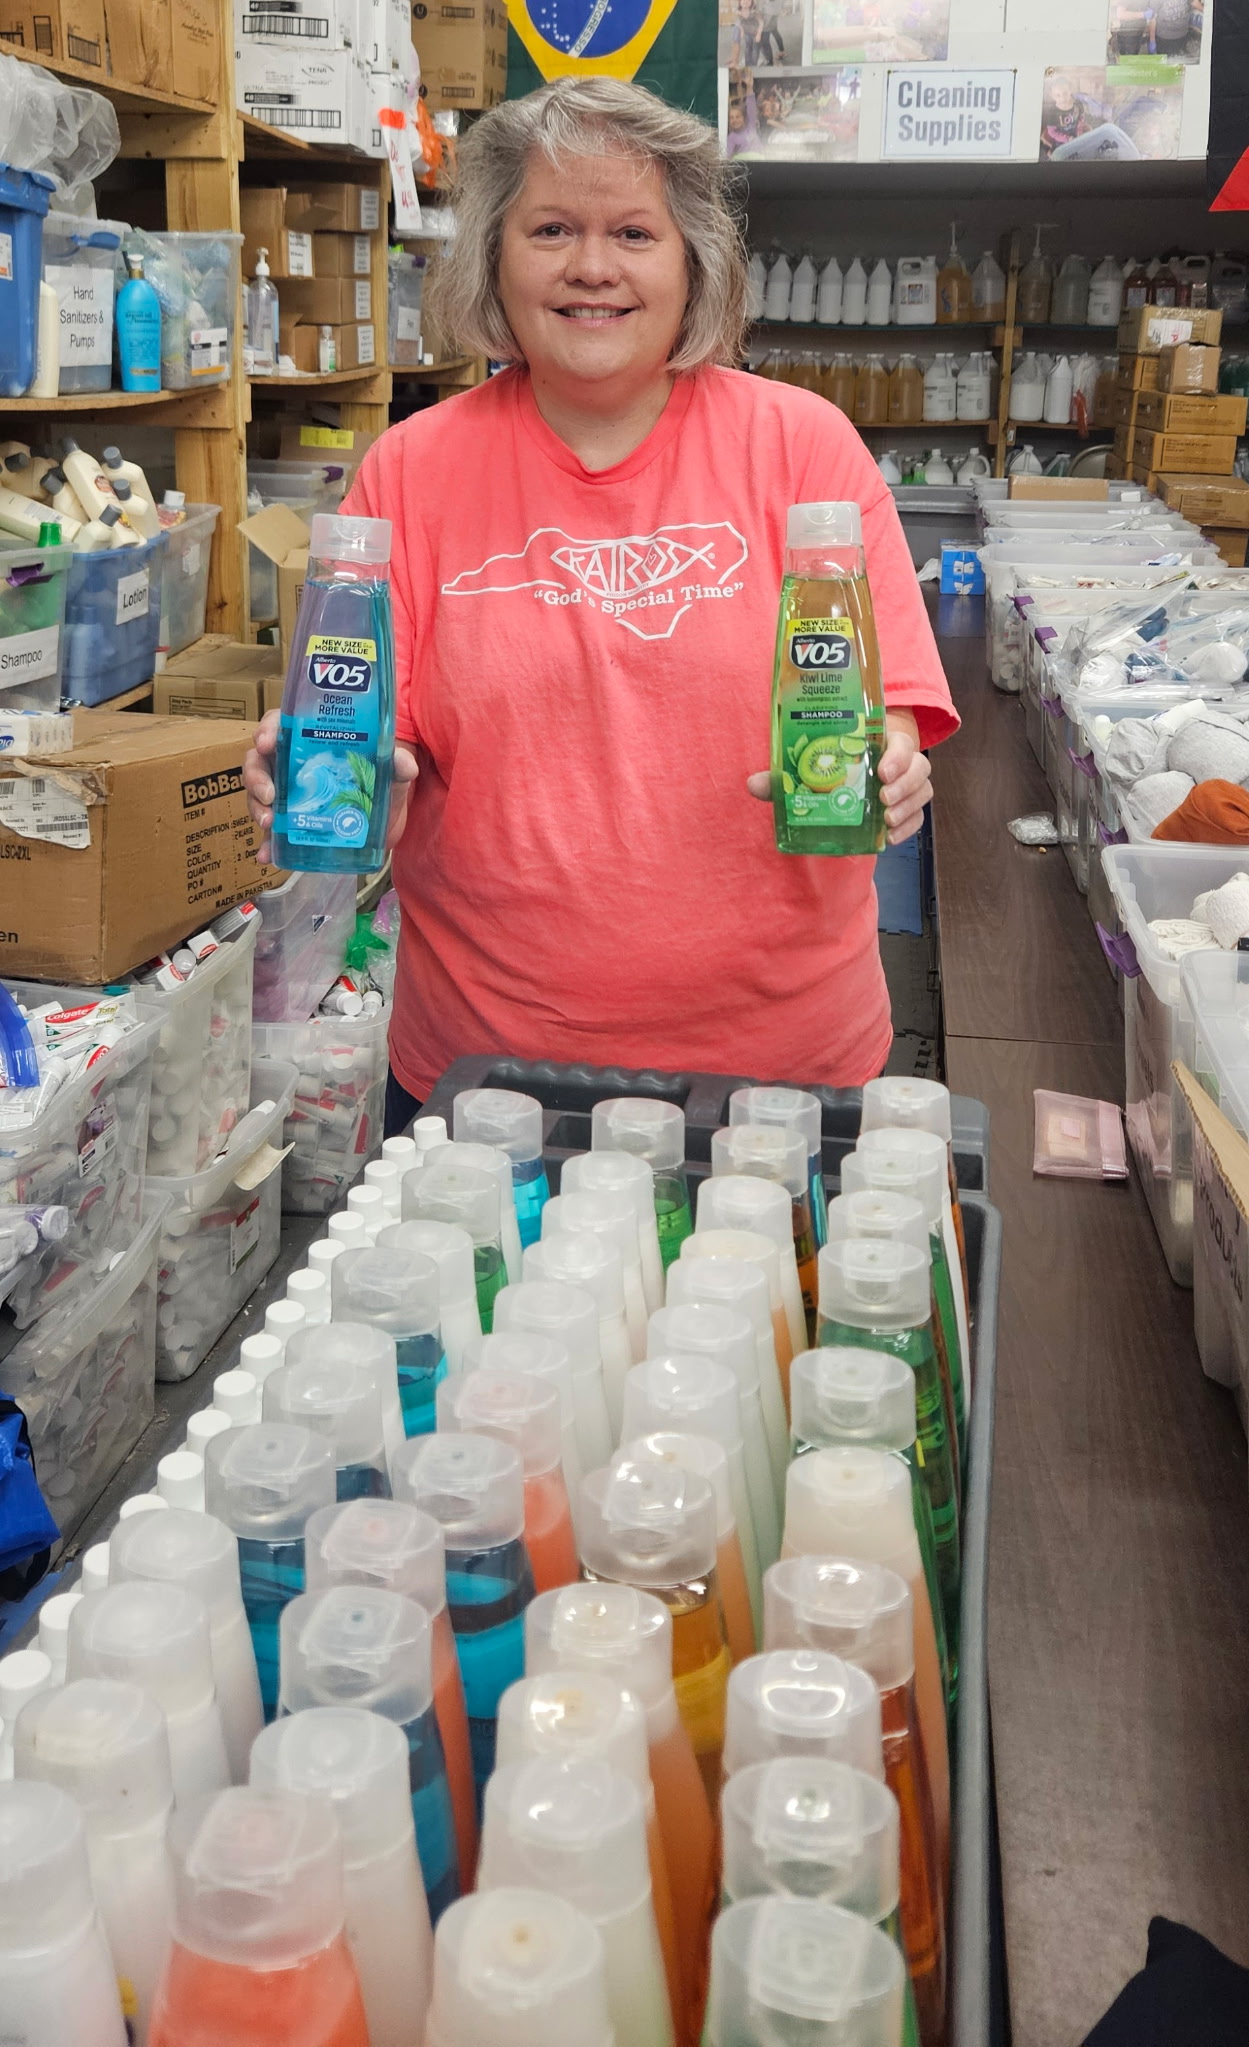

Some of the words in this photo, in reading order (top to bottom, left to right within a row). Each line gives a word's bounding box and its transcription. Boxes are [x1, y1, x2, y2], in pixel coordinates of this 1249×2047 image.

[897, 80, 1000, 112] Cleaning
[898, 113, 1000, 146] Supplies
[73, 286, 94, 301] Hand
[60, 309, 98, 324] Sanitizers
[98, 311, 104, 324] &
[70, 334, 95, 350] Pumps
[123, 587, 148, 609] Lotion
[601, 589, 675, 618] Special
[819, 625, 846, 633] VALUE
[314, 645, 339, 653] MORE
[341, 647, 369, 655] VALUE
[322, 639, 342, 647] NEW
[344, 640, 362, 648] SIZE
[1, 649, 43, 670] Shampoo
[315, 656, 337, 664] Alberto
[794, 641, 847, 665] VO5
[313, 663, 368, 687] VO5
[800, 673, 819, 683] Kiwi
[820, 672, 843, 683] Lime
[801, 684, 841, 696] Squeeze
[323, 693, 353, 706] Ocean
[318, 704, 356, 717] Refresh
[801, 711, 843, 719] SHAMPOO
[313, 730, 357, 740] SHAMPOO
[184, 809, 201, 822] ITEM
[306, 815, 332, 823] Vitamins
[186, 822, 230, 845] DESCRIPTION
[186, 843, 202, 857] SIZE
[187, 852, 212, 868] COLOR
[187, 860, 222, 880] QUANTITY
[187, 880, 198, 892] PO
[215, 896, 237, 910] MADE
[236, 893, 244, 902] IN
[46, 1008, 89, 1022] Colgate
